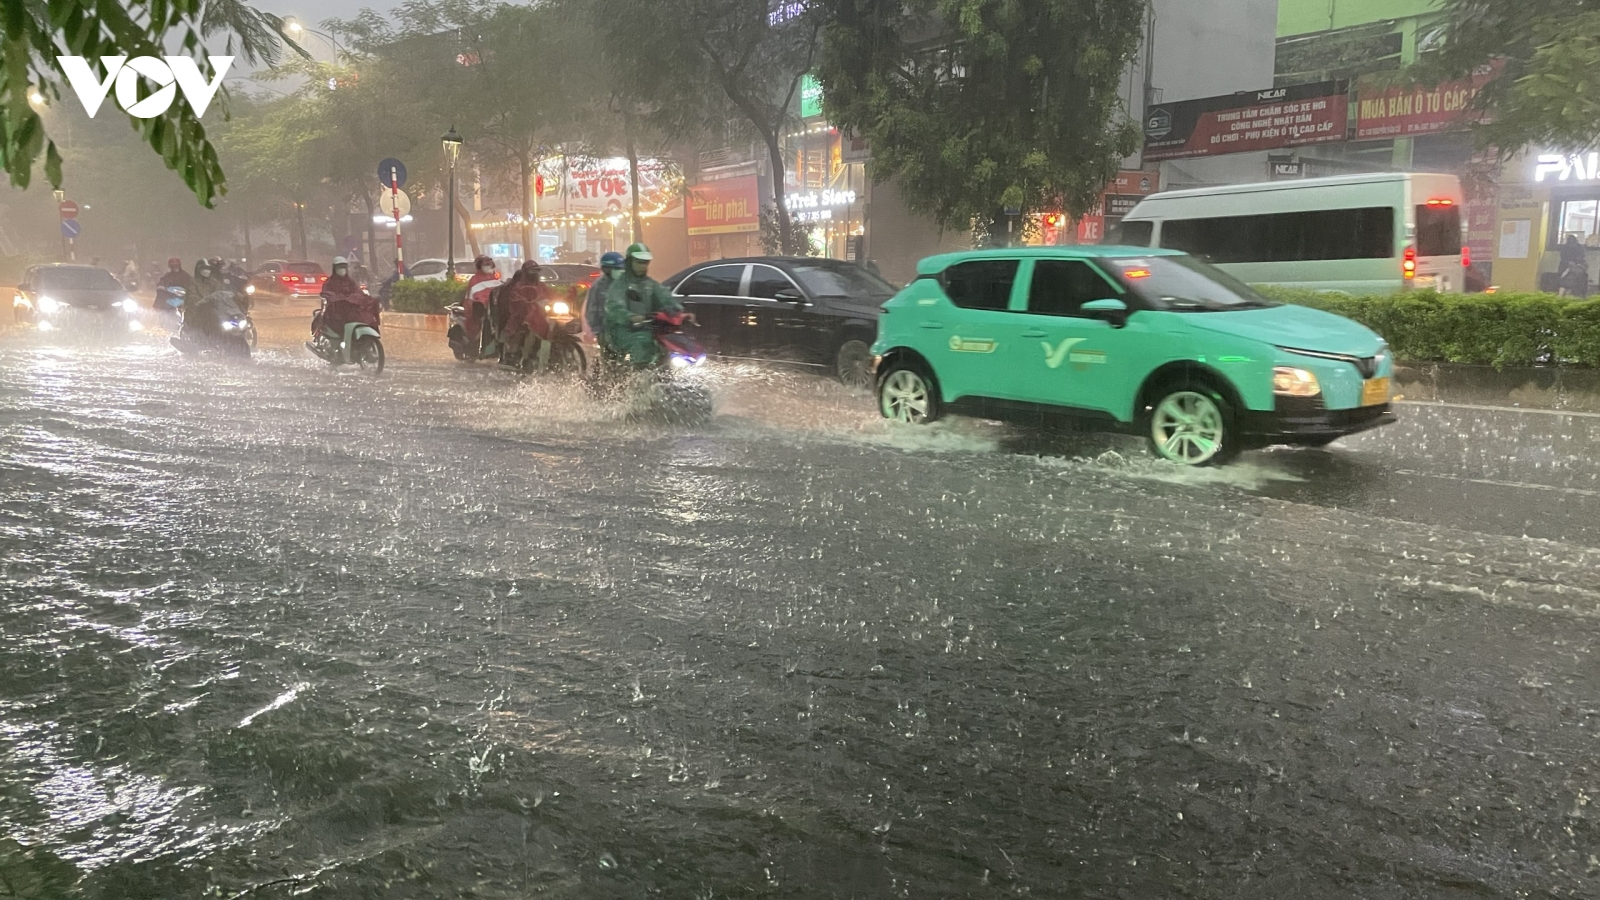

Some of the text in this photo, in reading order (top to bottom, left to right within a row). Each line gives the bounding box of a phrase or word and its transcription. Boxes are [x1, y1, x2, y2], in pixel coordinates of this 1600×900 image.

[1257, 88, 1286, 101] NICAR
[1361, 98, 1386, 119] MUA
[1389, 91, 1412, 117] BÁN
[1427, 88, 1441, 113] TÔ
[1217, 114, 1241, 122] TRUNG
[1242, 110, 1258, 120] TÂM
[1283, 103, 1299, 114] SÓC
[1300, 102, 1312, 112] XE
[1313, 100, 1326, 110] HƠI
[1231, 113, 1312, 131] CÔNG NGHỆ NHẬT BẢN
[1221, 132, 1239, 143] CHƠI
[1245, 130, 1260, 141] PHỤ
[1262, 127, 1280, 139] KIỆN
[1299, 124, 1316, 134] CAO
[1317, 120, 1333, 132] CẤP
[1275, 164, 1298, 175] NICAR
[822, 188, 856, 206] Store
[705, 197, 753, 222] tiến phát
[1084, 221, 1098, 239] XE
